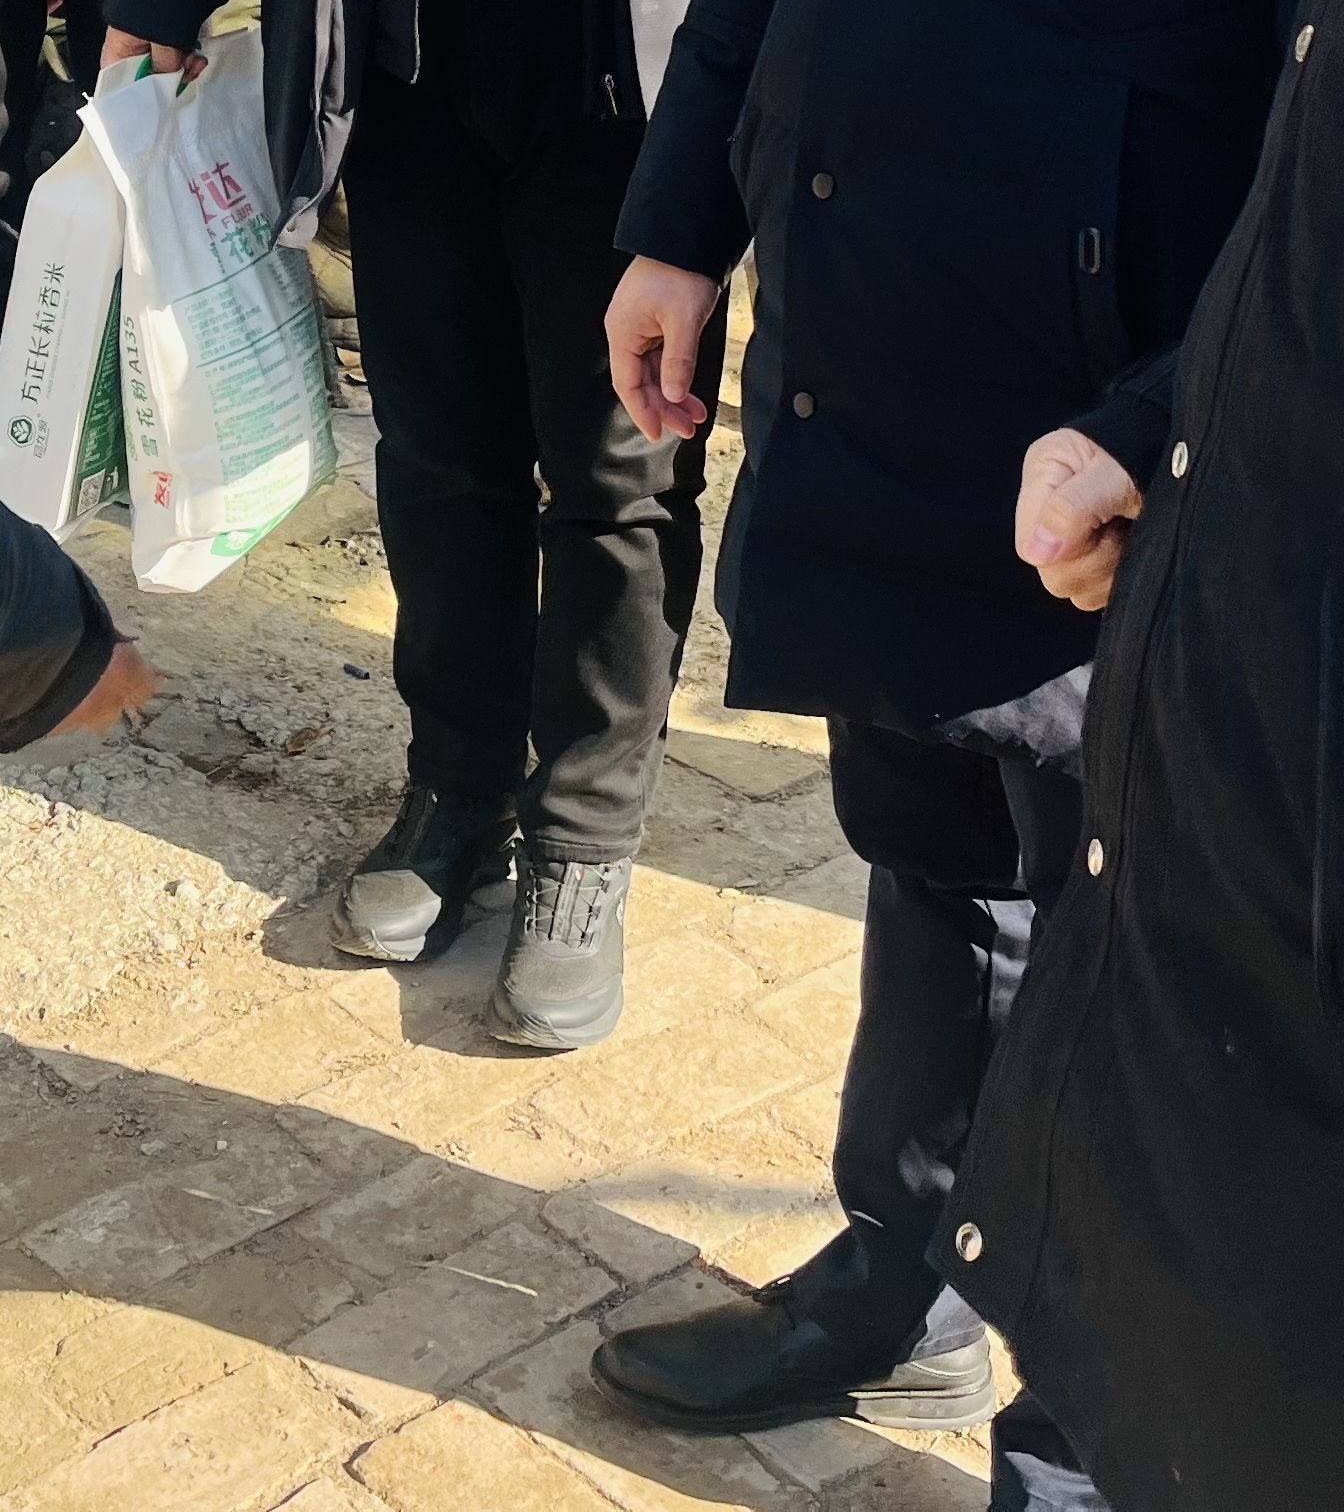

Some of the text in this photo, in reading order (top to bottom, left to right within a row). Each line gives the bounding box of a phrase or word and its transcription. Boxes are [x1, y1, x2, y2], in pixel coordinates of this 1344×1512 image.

[21, 262, 65, 405] 方正长粒香米
[123, 315, 143, 375] A135
